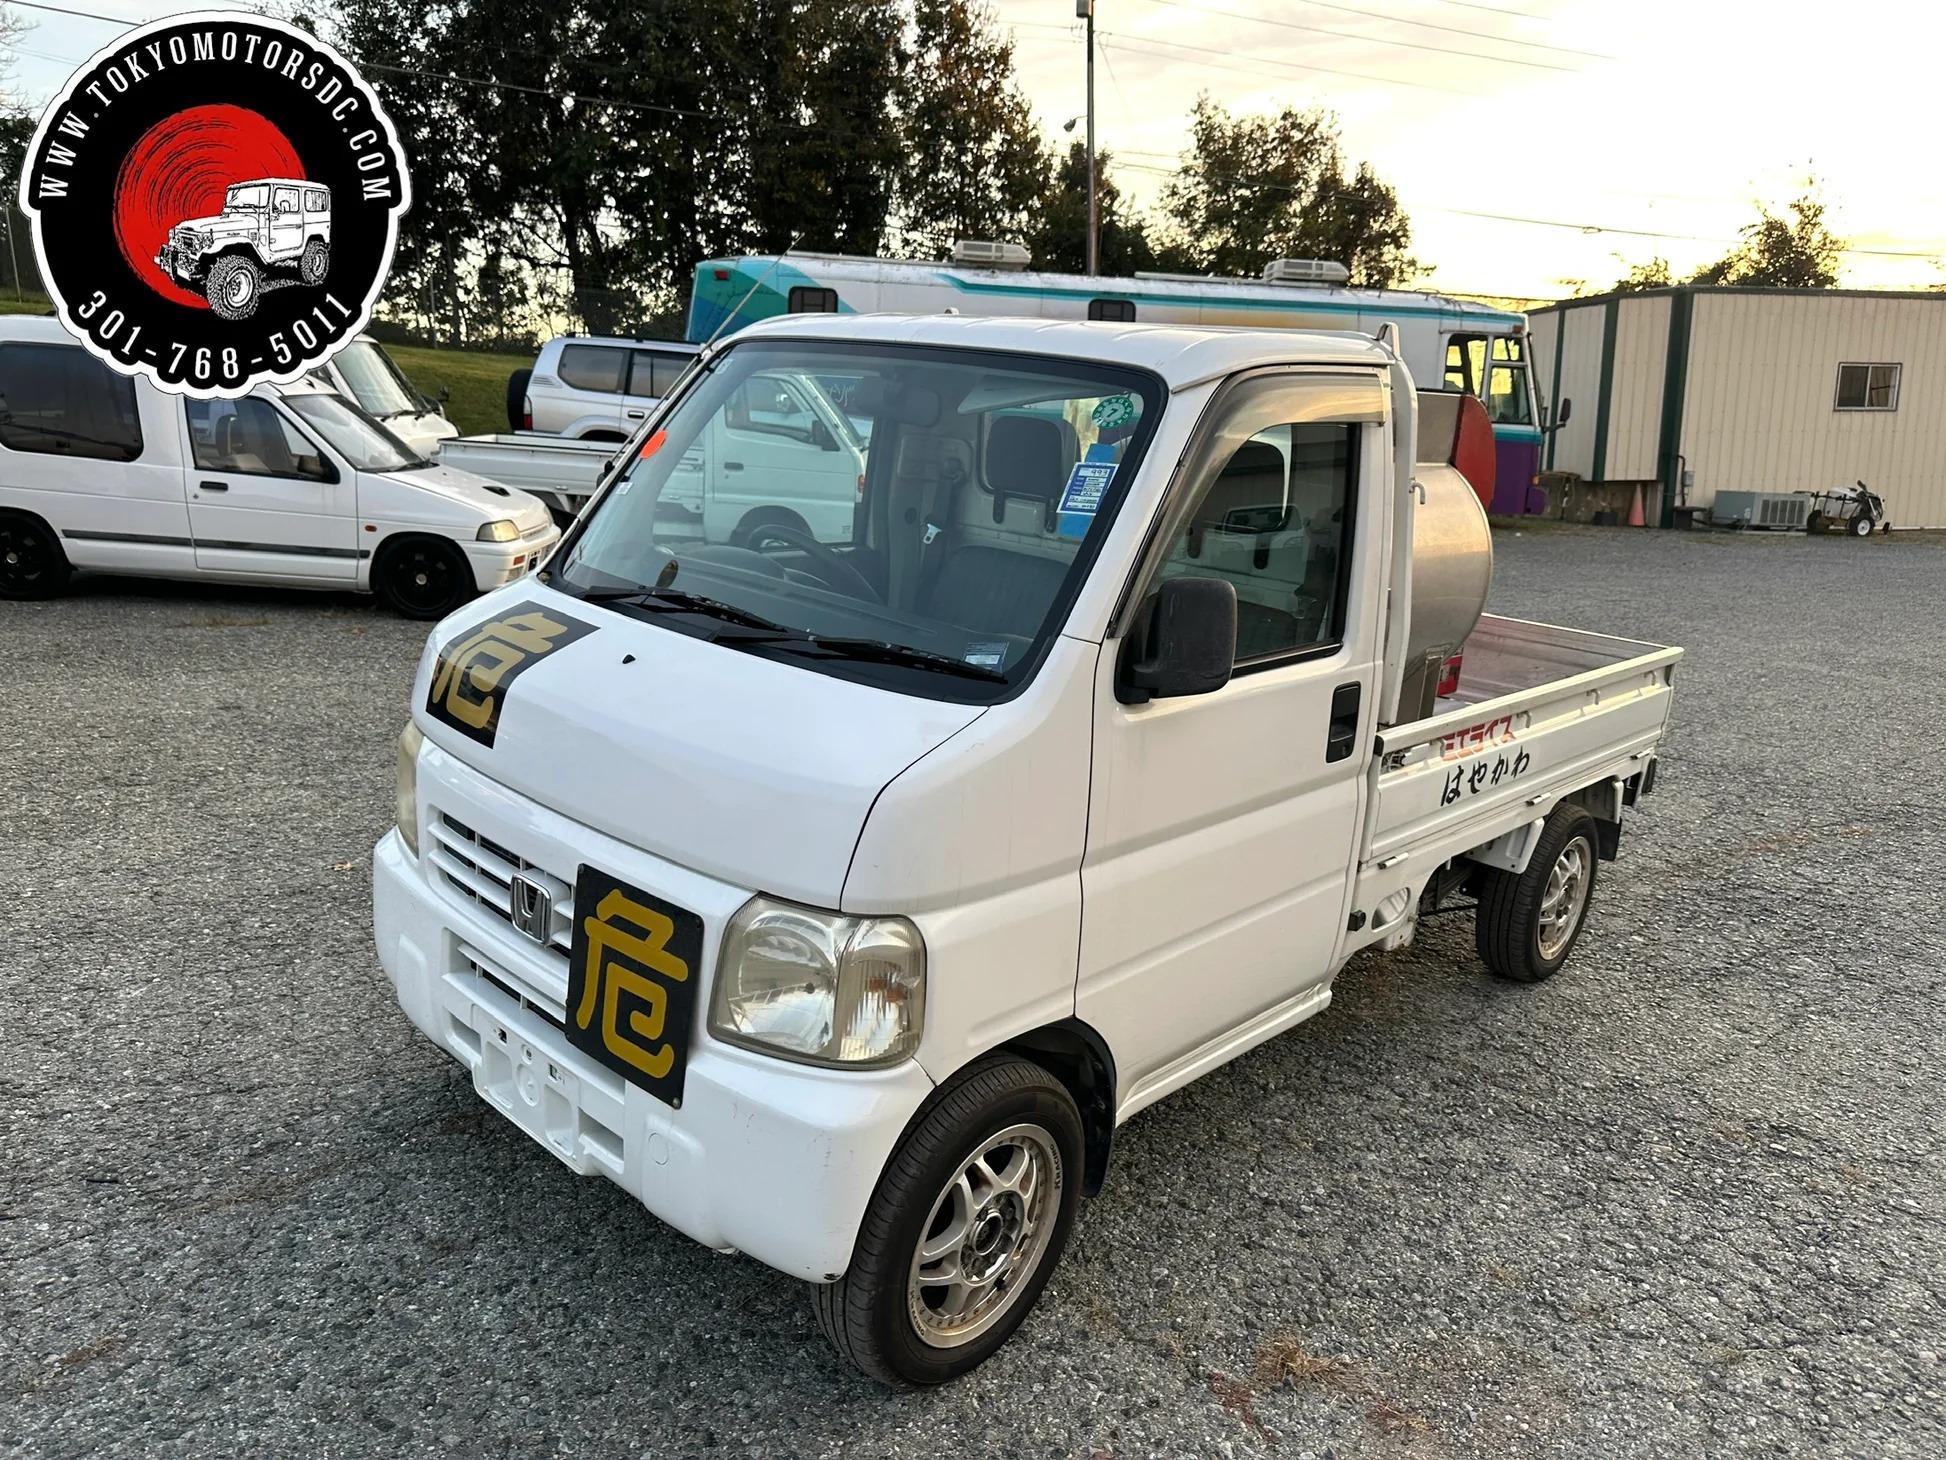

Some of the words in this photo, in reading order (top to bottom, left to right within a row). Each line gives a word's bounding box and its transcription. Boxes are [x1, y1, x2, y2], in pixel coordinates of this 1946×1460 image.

[432, 610, 568, 730] 危
[1440, 745, 1531, 807] はやかわ
[576, 888, 690, 1080] 危
